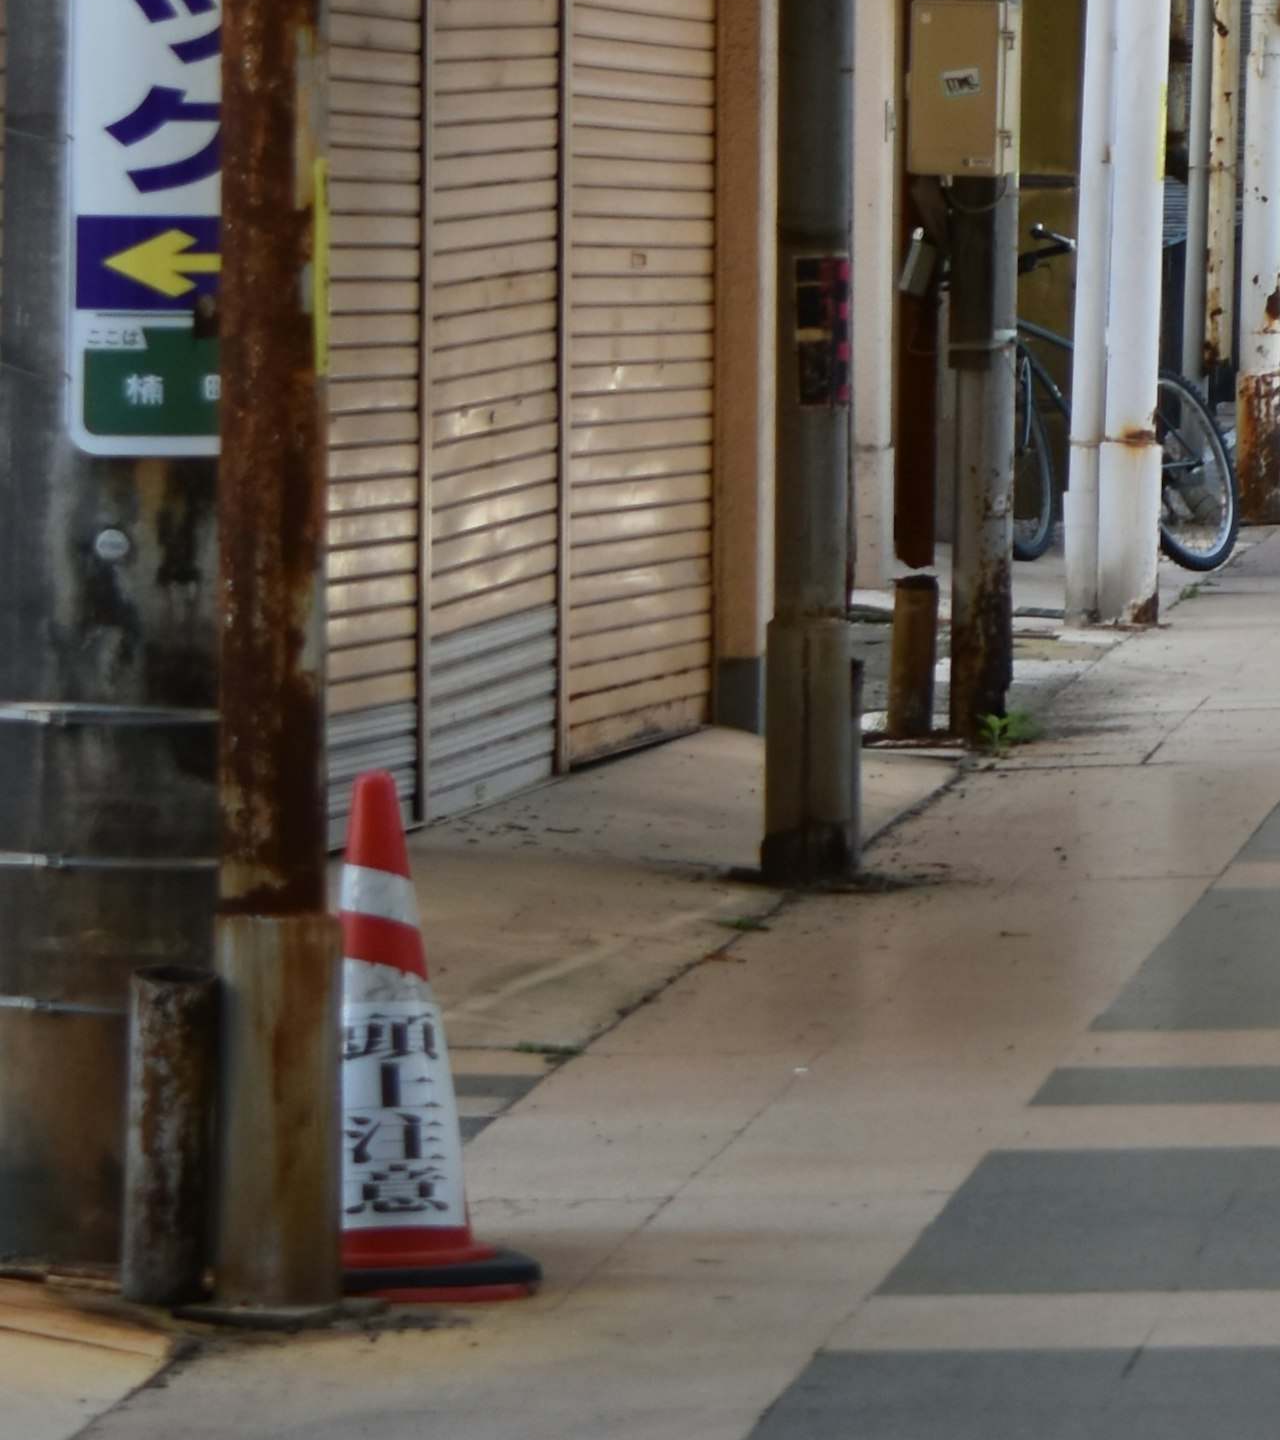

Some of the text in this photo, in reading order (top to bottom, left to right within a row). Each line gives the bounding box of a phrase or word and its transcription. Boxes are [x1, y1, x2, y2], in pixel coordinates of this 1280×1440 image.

[88, 329, 139, 346] ここは
[343, 1012, 449, 1215] 頭上注意
